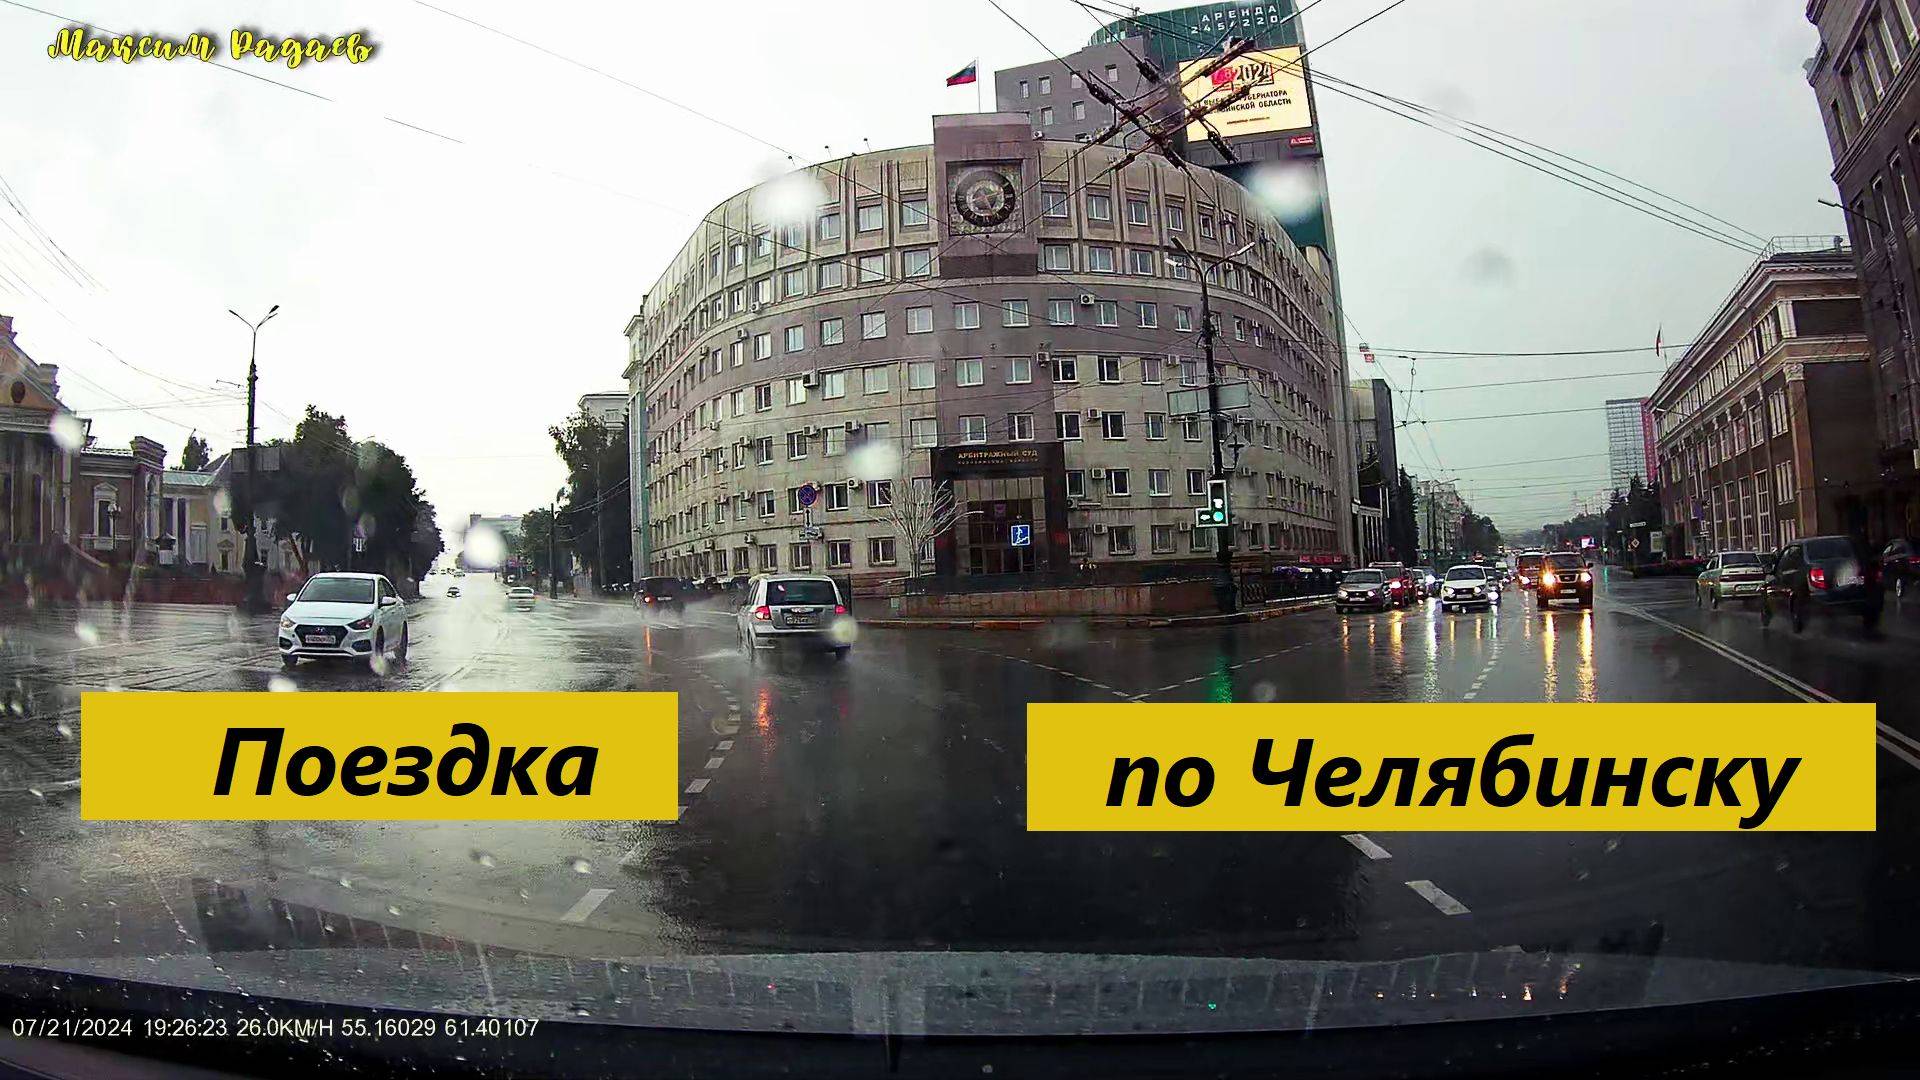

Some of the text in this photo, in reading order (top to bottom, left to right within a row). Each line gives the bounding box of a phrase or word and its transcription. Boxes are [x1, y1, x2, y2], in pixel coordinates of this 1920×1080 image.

[1202, 5, 1277, 22] АРЕНДА
[1258, 98, 1292, 108] ОБЛАСТИ
[958, 449, 1038, 459] АРБИТРАЖНЫЙ СУД
